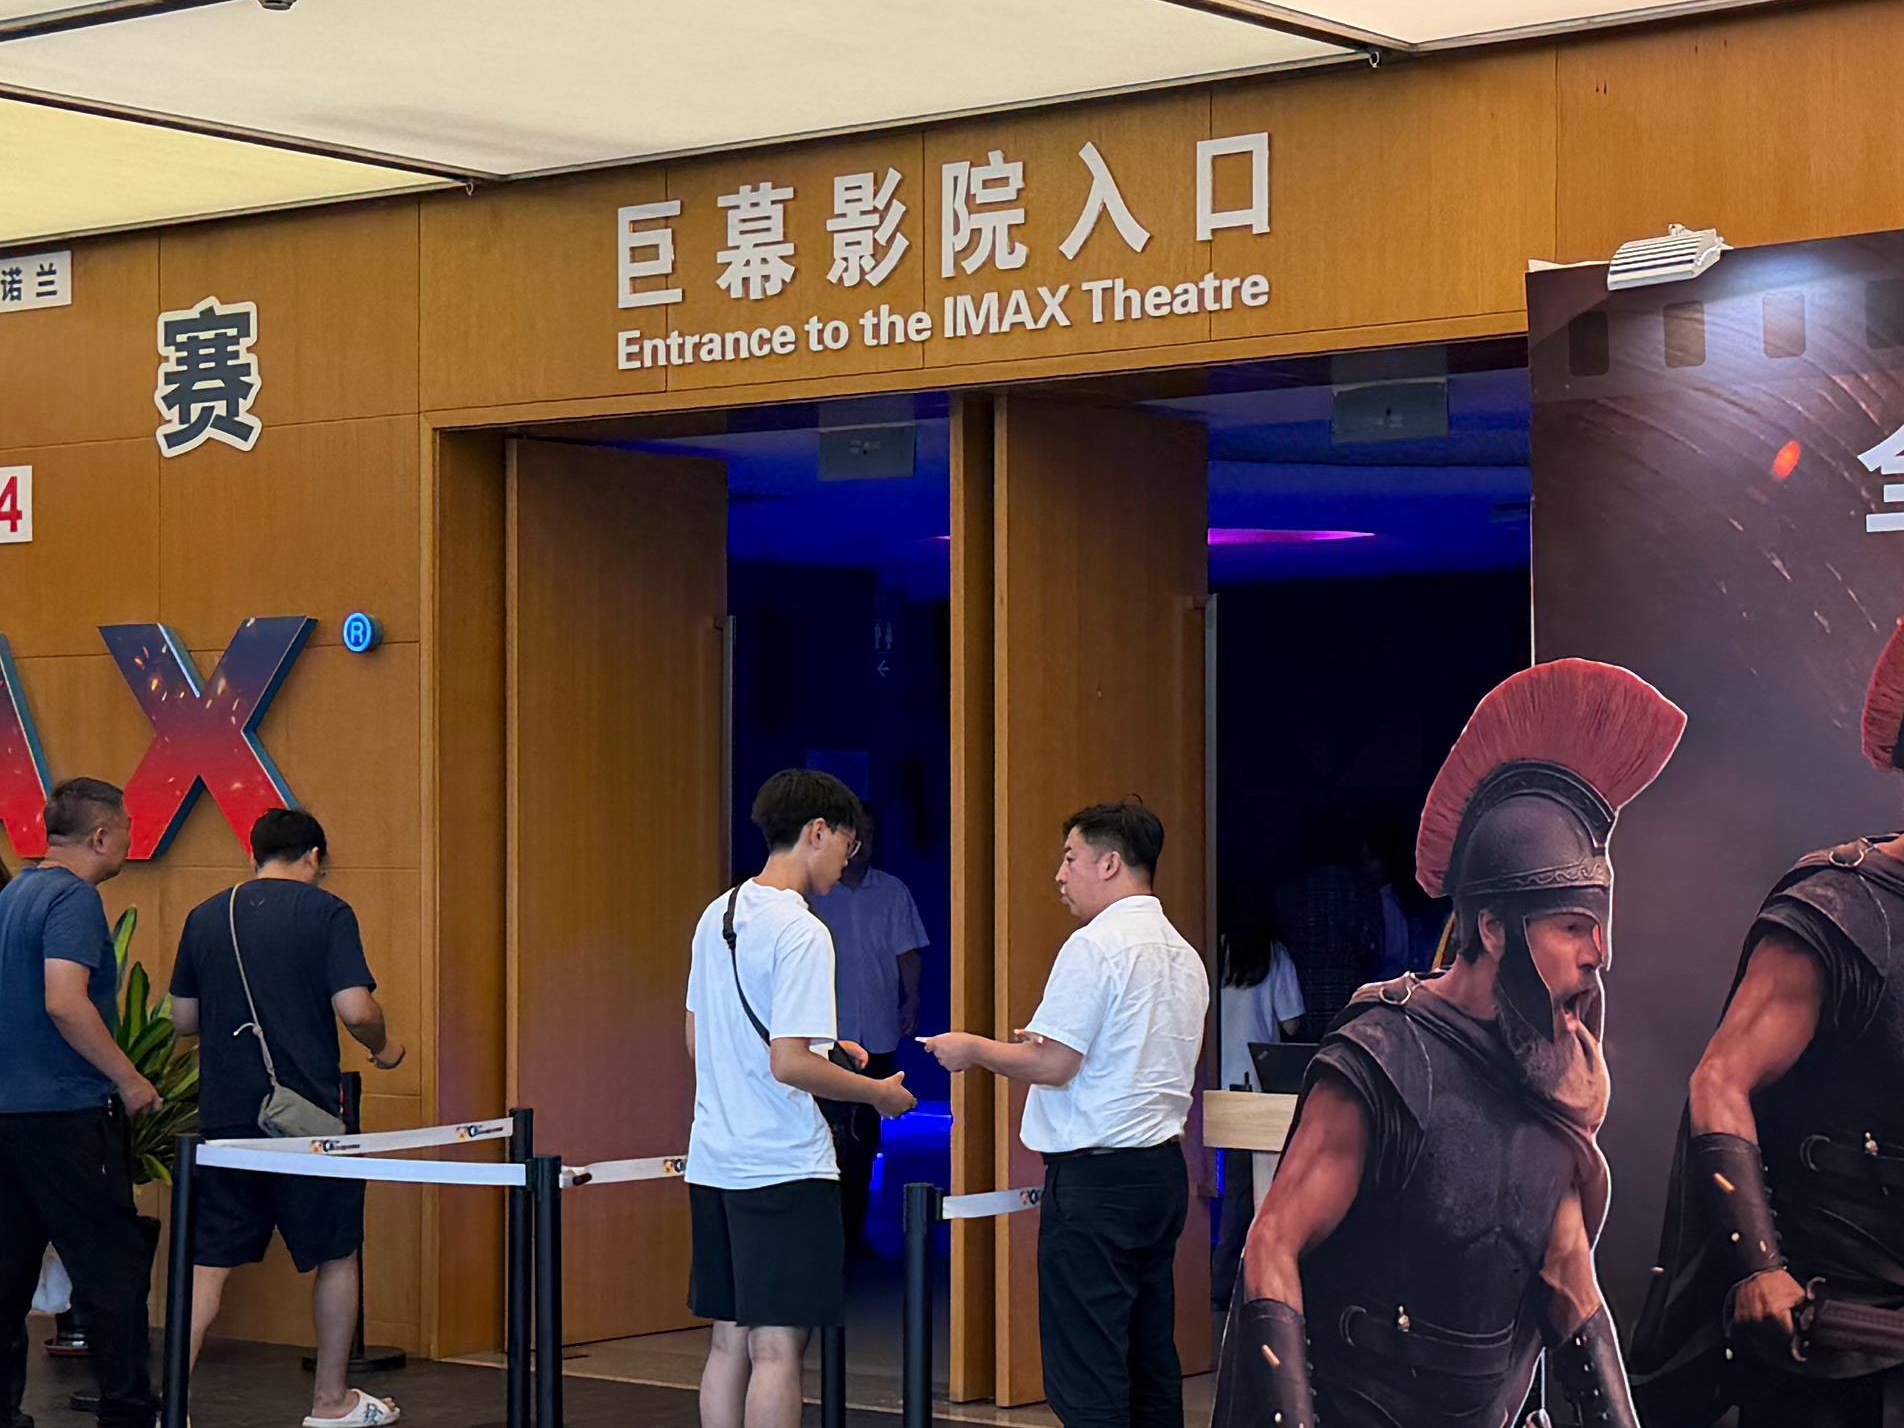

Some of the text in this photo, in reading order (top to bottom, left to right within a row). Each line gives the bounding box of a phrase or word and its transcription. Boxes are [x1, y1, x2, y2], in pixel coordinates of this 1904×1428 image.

[617, 133, 1270, 310] 巨幕影院入口
[617, 272, 1271, 371] Entrance to the IMAX Theatre
